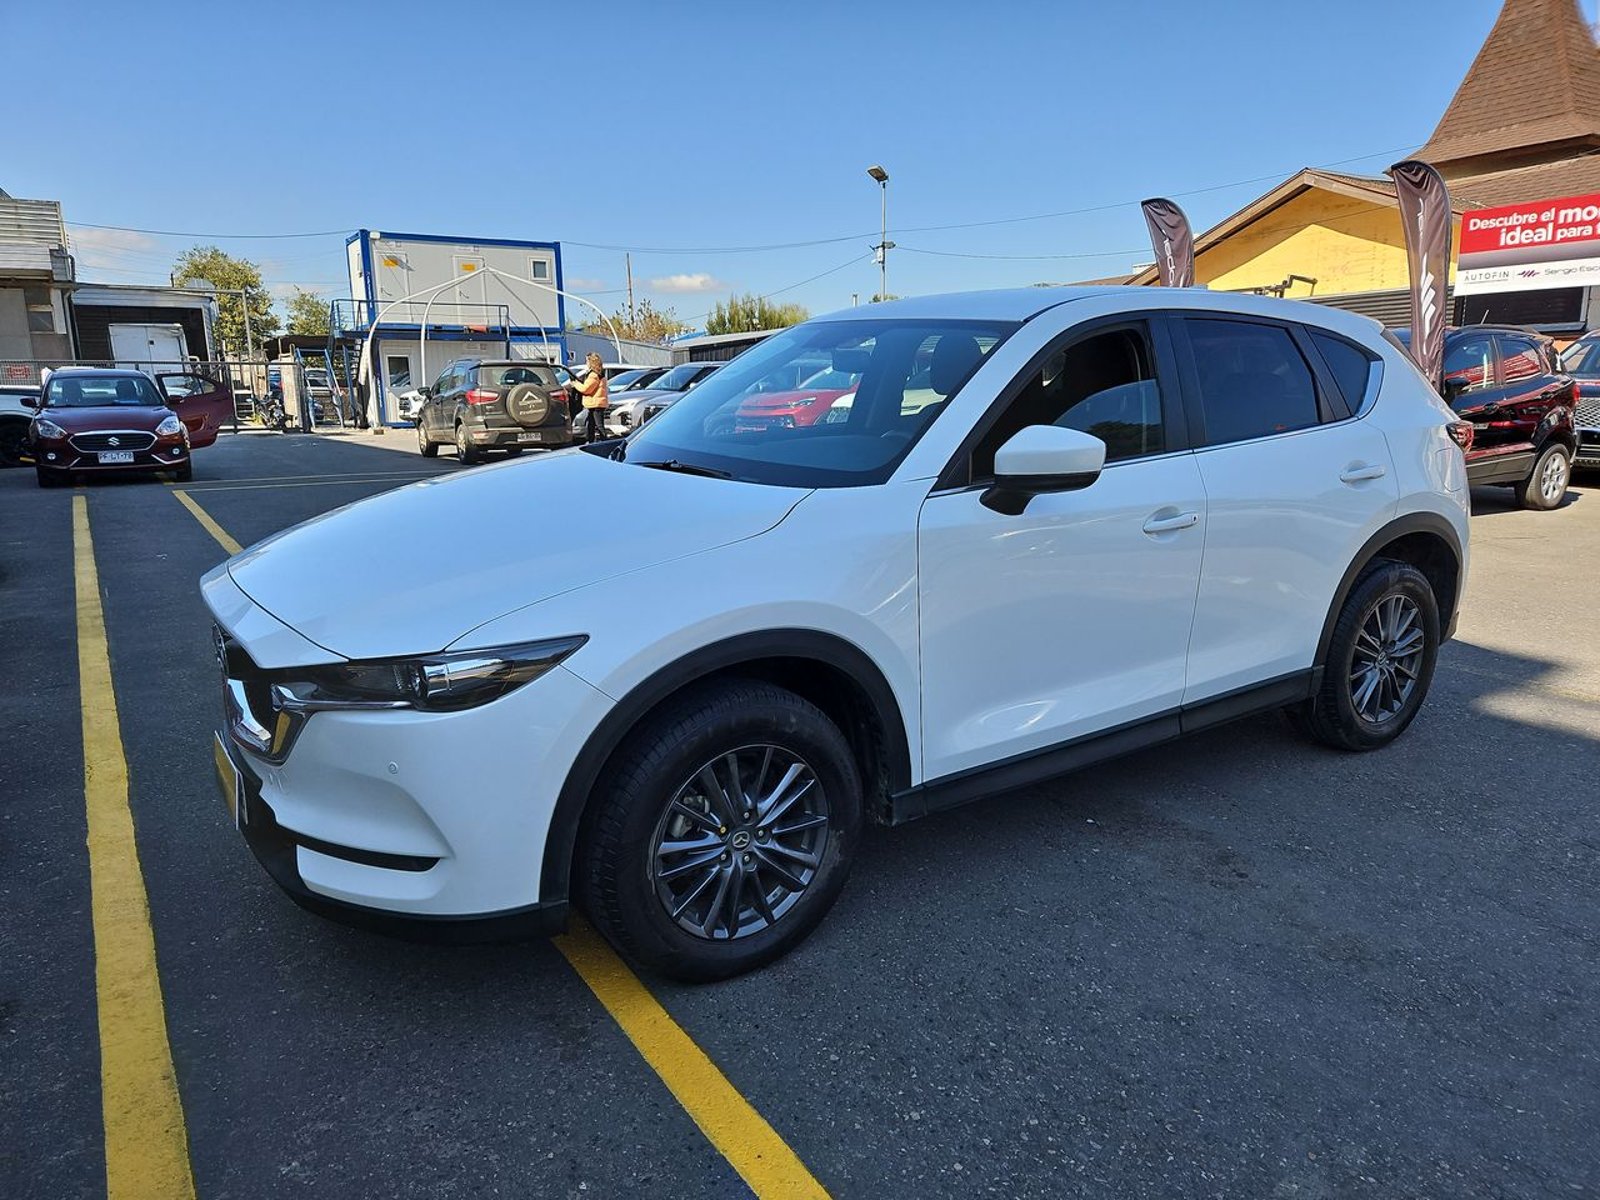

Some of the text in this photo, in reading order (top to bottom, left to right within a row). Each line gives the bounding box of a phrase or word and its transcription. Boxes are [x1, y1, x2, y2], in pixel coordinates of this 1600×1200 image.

[1469, 205, 1600, 231] Descubre el mo
[1499, 222, 1554, 246] ideal
[1556, 225, 1593, 241] para
